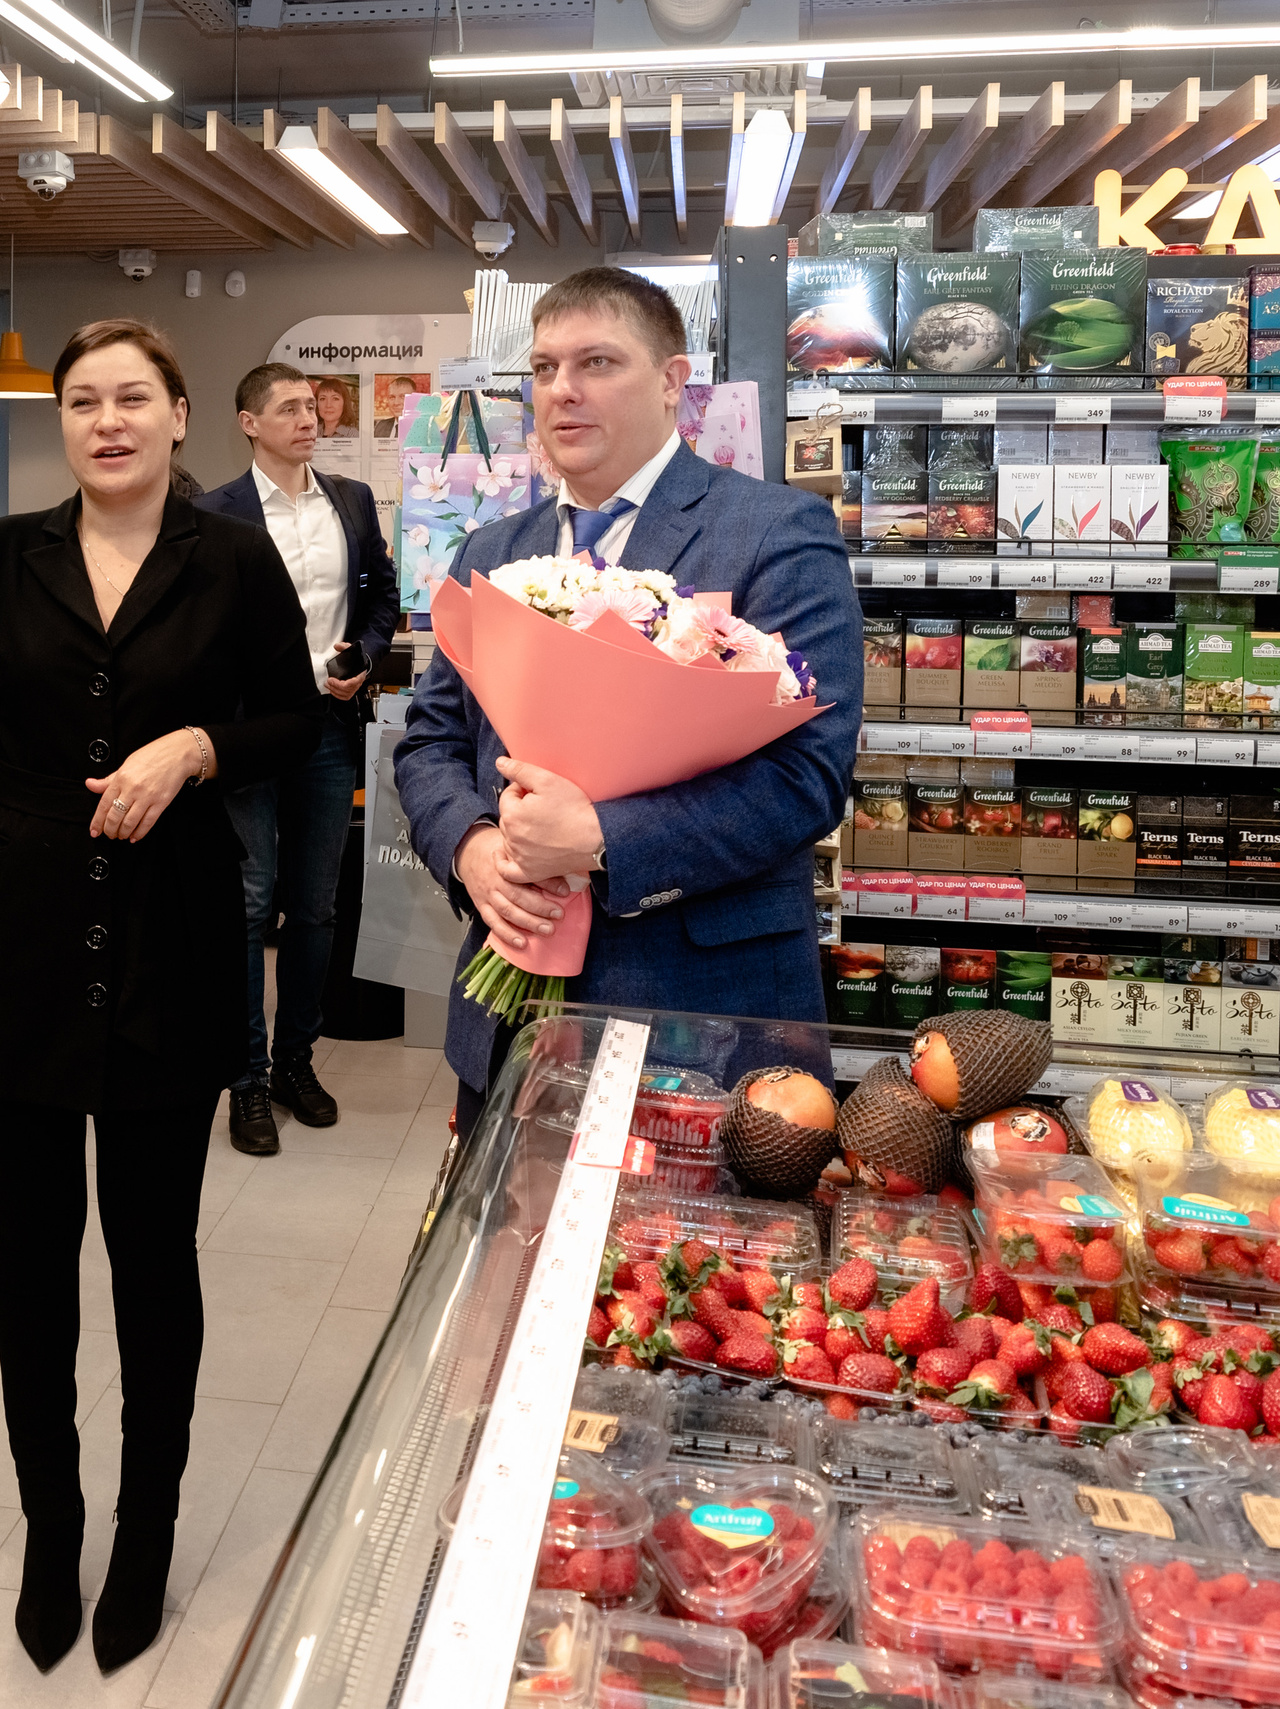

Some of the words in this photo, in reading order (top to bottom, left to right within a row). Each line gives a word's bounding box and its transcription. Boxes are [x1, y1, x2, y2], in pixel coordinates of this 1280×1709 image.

[1015, 213, 1062, 227] Greenfield
[1052, 262, 1115, 279] Greenfield
[804, 268, 863, 285] Greenfield
[926, 266, 988, 286] Greenfield
[923, 287, 940, 295] EARL
[963, 286, 994, 294] FANTASY
[1050, 283, 1079, 291] FLYING
[1156, 286, 1213, 296] RICHARD
[299, 342, 423, 362] информация
[973, 409, 989, 418] 349
[1087, 409, 1104, 417] 349
[1198, 409, 1212, 418] 139
[1011, 472, 1041, 480] NEWBY
[1068, 472, 1098, 480] NEWBY
[872, 479, 917, 491] Greenfield
[939, 479, 985, 491] Greenfield
[903, 574, 916, 582] 109
[968, 575, 983, 583] 109
[1030, 575, 1047, 583] 448
[1087, 576, 1104, 584] 422
[1145, 577, 1162, 585] 422
[913, 624, 955, 634] Greenfield
[972, 624, 1015, 635] Greenfield
[1029, 626, 1071, 636] Greenfield
[1149, 653, 1163, 661] Earl
[1146, 663, 1164, 672] Grey
[897, 741, 911, 749] 109
[951, 742, 965, 750] 109
[1012, 745, 1023, 753] 64
[1121, 748, 1132, 756] 88
[862, 783, 903, 795] Greenfield
[917, 787, 958, 798] Greenfield
[973, 790, 1015, 802] Greenfield
[1030, 791, 1071, 803] Greenfield
[1088, 794, 1130, 806] Greenfield
[1140, 831, 1178, 843] Terns
[1187, 832, 1224, 844] Terns
[1239, 830, 1280, 843] Terns
[1094, 845, 1120, 853] LEMON
[861, 878, 878, 886] УДАР
[917, 880, 933, 888] УДАР
[969, 881, 986, 889] УДАР
[998, 882, 1022, 890] ЦЕНАМ!
[1053, 913, 1068, 921] 109
[1108, 916, 1123, 924] 109
[1168, 918, 1180, 927] 89
[1226, 921, 1238, 929] 89
[836, 980, 878, 992] Greenfield
[892, 983, 933, 996] Greenfield
[947, 987, 989, 999] Greenfield
[1002, 989, 1045, 1002] Greenfield
[1055, 989, 1104, 1009] Saito
[1110, 991, 1160, 1012] Saito
[1168, 996, 1218, 1016] Saito
[1226, 1000, 1276, 1020] Saito
[1037, 1081, 1051, 1089] 109
[703, 1512, 762, 1527] Artfruit
